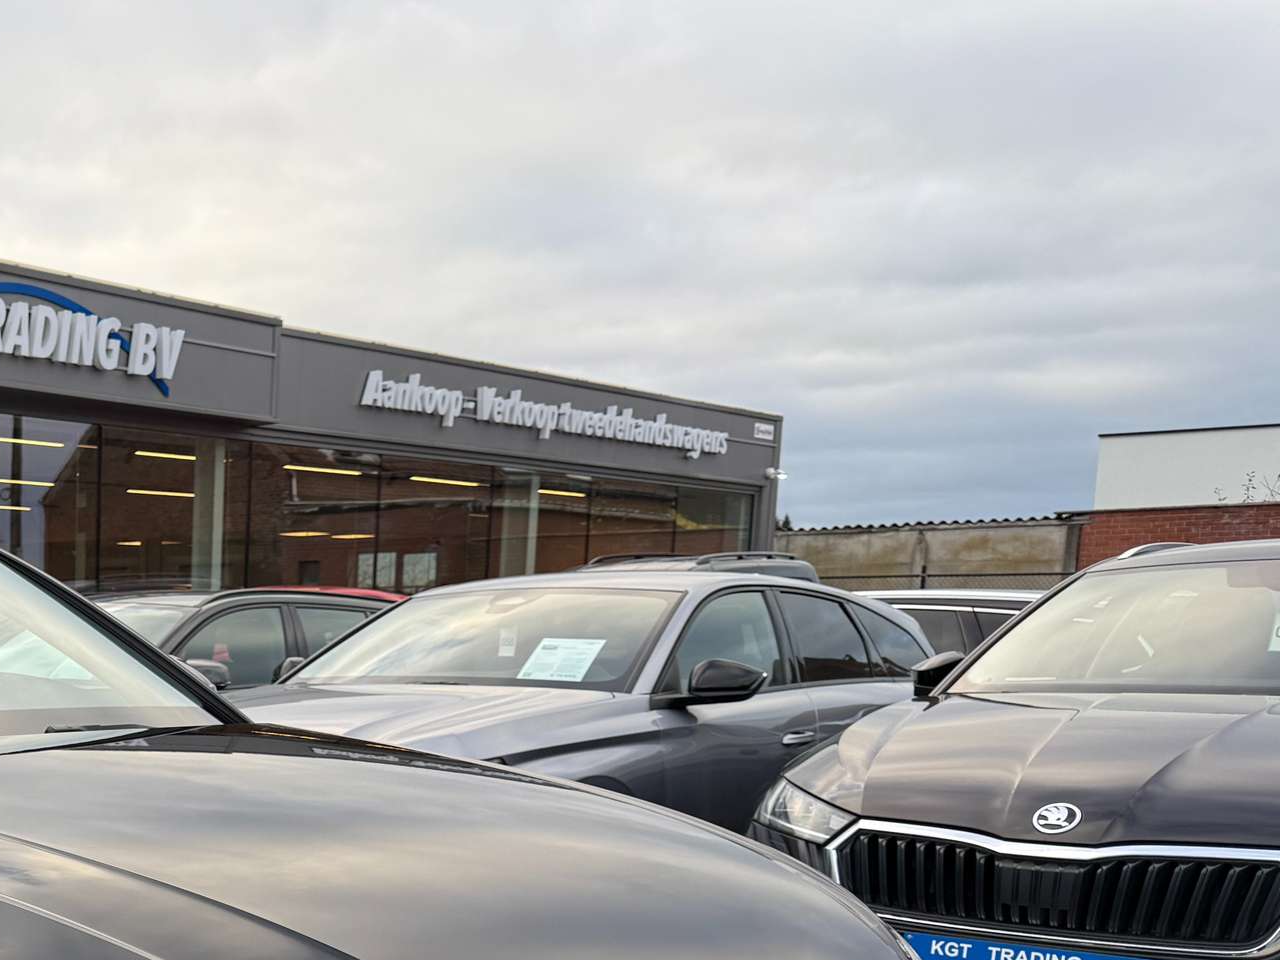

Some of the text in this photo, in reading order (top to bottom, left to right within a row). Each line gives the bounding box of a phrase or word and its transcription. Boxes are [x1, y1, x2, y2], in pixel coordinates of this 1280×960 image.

[127, 322, 185, 380] BV
[360, 370, 463, 427] Aankoop
[477, 386, 558, 440] Verkoop
[558, 402, 729, 459] tweedehandswagens
[930, 939, 972, 959] KGT
